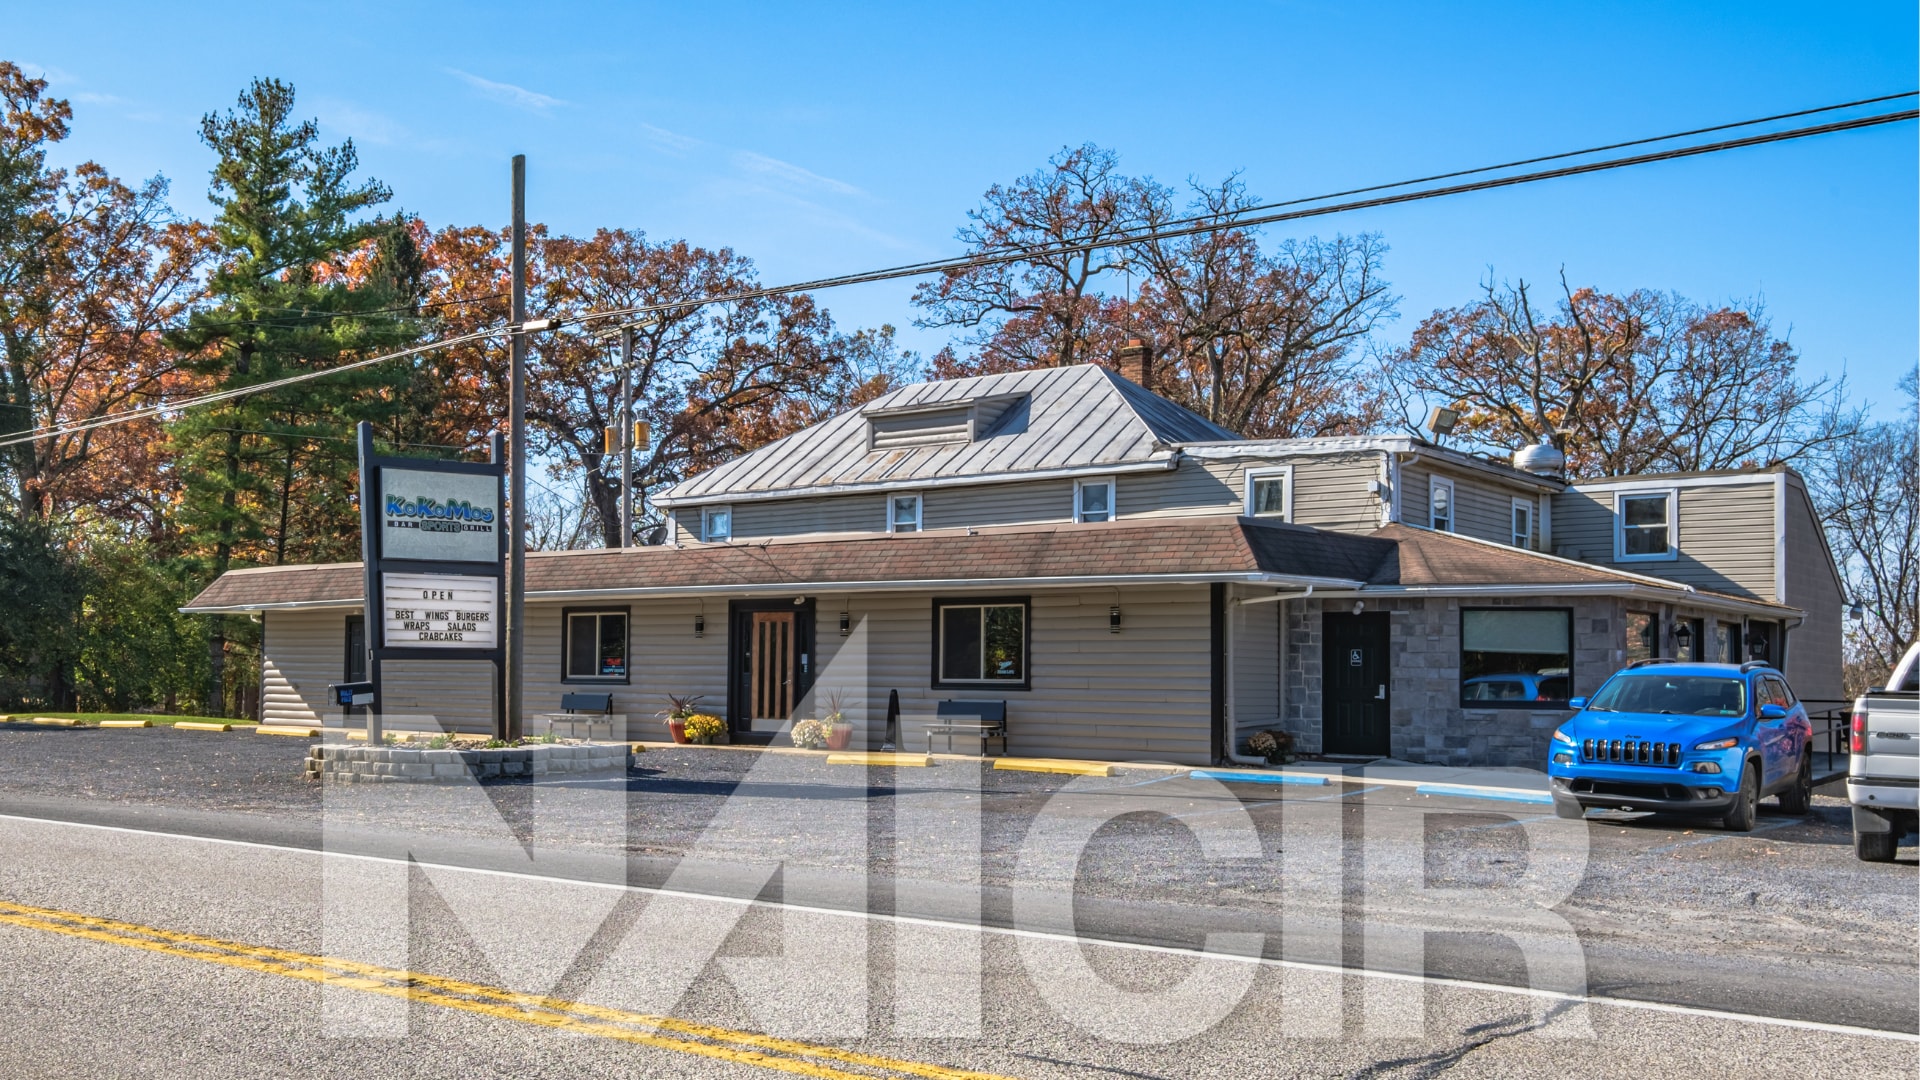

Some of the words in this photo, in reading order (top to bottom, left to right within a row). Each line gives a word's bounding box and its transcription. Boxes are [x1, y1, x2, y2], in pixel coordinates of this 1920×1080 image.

[393, 520, 414, 528] BAR
[421, 520, 461, 533] SPORTS
[463, 524, 491, 532] GRILL
[422, 590, 454, 600] OPEN
[395, 610, 414, 620] BEST
[425, 611, 449, 621] WINGS
[456, 612, 489, 622] BURGERS
[403, 621, 430, 631] WRAPS
[447, 622, 476, 632] SALADS
[418, 632, 463, 642] CRABCAKES
